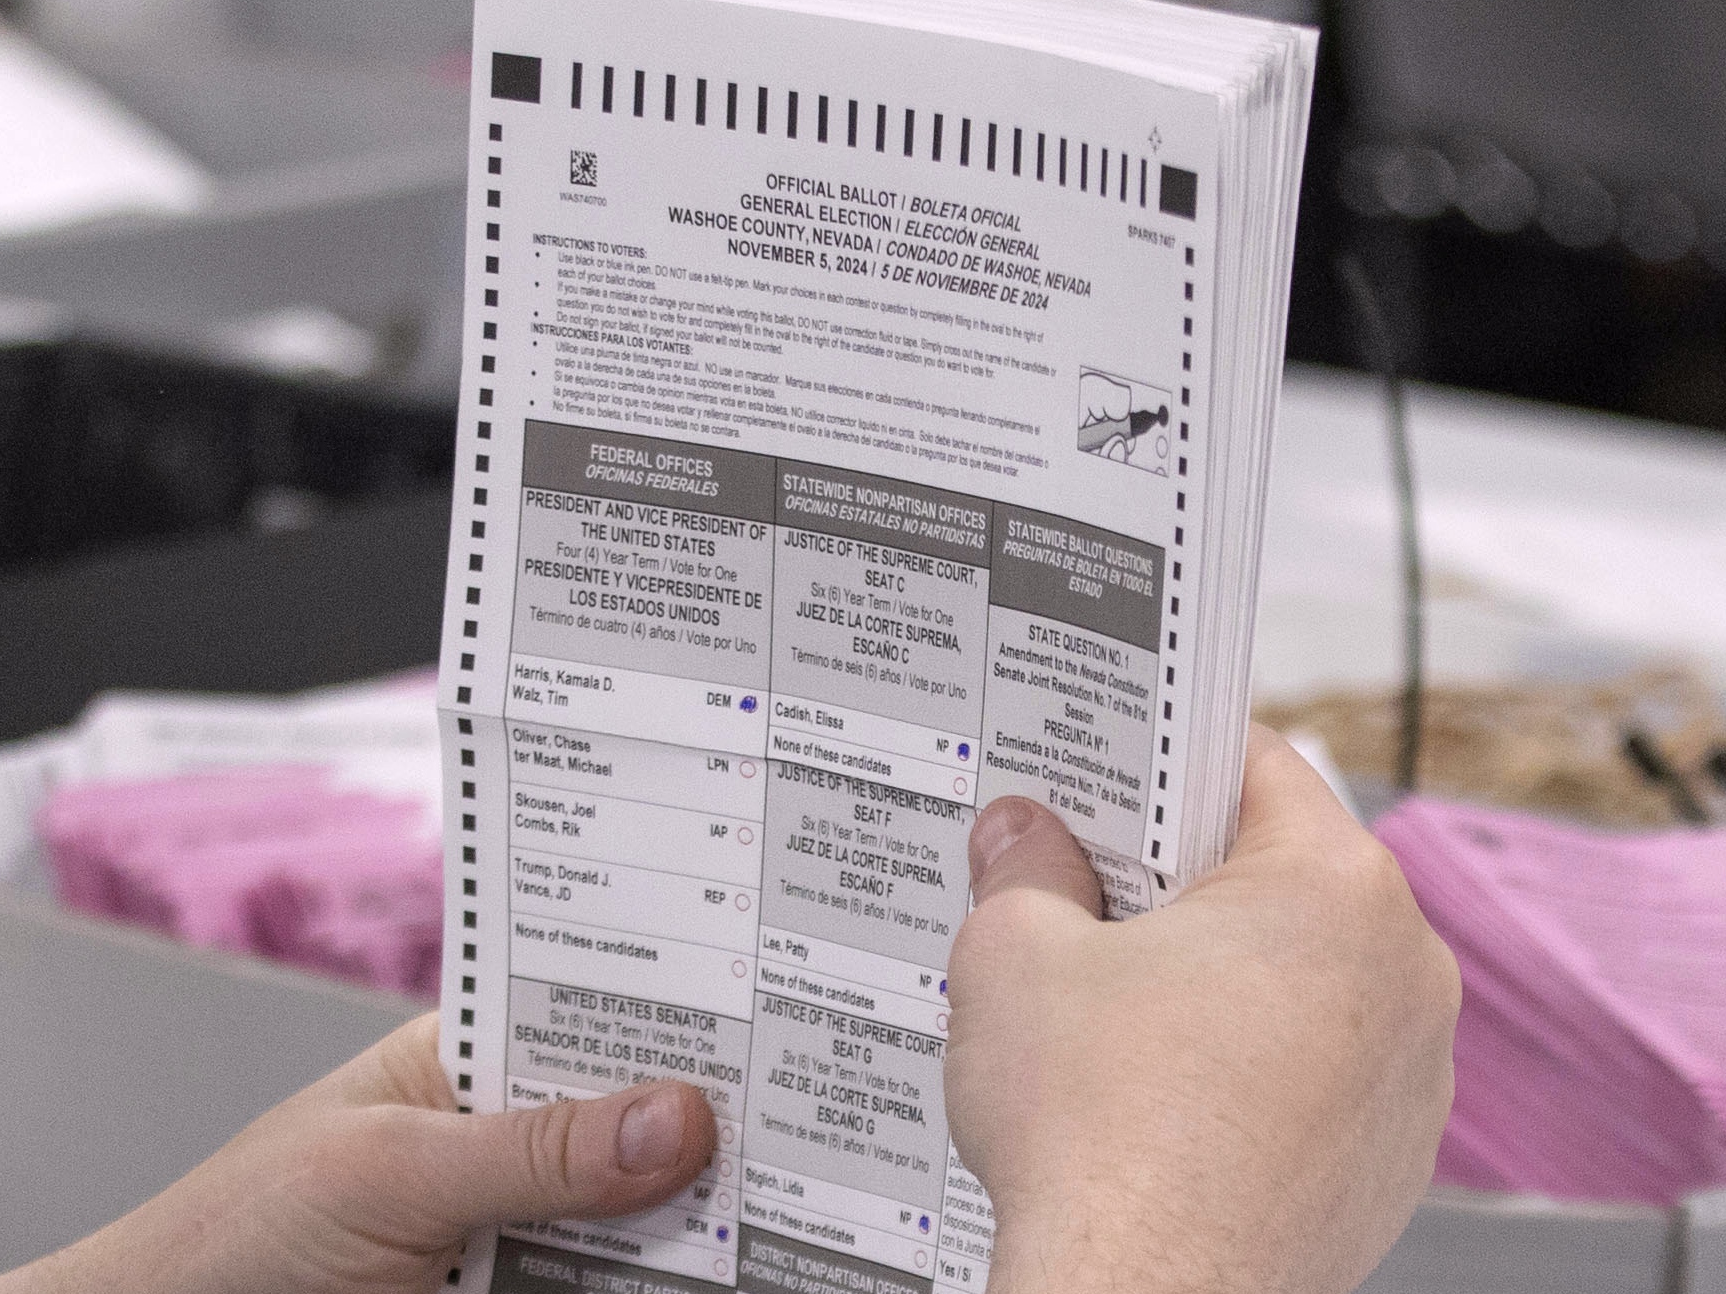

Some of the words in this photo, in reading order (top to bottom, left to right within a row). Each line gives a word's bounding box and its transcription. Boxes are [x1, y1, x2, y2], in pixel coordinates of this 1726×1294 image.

[765, 173, 837, 201] OFFICIAL
[839, 186, 897, 211] BALLOT
[908, 197, 968, 223] BOLETA
[969, 208, 1022, 232] OFICIAL
[740, 194, 816, 222] GENERAL
[818, 207, 892, 235] ELECTION
[903, 221, 977, 250] ELECCIÓN
[978, 234, 1041, 261] GENERAL
[532, 233, 595, 252] INSTRUCTIONS
[597, 242, 609, 254] TO
[610, 244, 648, 259] VOTERS:
[668, 206, 738, 234] WASHOE
[740, 219, 809, 250] COUNTY,
[811, 232, 873, 258] NEVADA
[884, 245, 957, 273] CONDADO
[959, 258, 979, 277] DE
[982, 262, 1042, 291] WASHOE,
[1043, 273, 1092, 297] NEVADA
[727, 239, 815, 269] NOVEMBER
[819, 254, 831, 276] 5,
[835, 257, 867, 279] 2024
[879, 265, 889, 282] 5
[891, 267, 912, 286] DE
[914, 271, 997, 301] NOVIEMBRE
[999, 286, 1018, 305] DE
[1020, 290, 1050, 311] 2024
[530, 322, 599, 342] INSTRUCCIONES
[600, 332, 624, 346] PARA
[626, 336, 644, 349] LOS
[645, 338, 694, 356] VOTANTES:
[590, 443, 651, 468] FEDERAL
[654, 453, 713, 477] OFFICES
[584, 464, 644, 487] OFICINAS
[644, 472, 720, 497] FEDERALES
[526, 490, 602, 516] PRESIDENT
[604, 502, 634, 521] AND
[637, 506, 668, 526] VICE
[671, 512, 746, 538] PRESIDENT
[748, 523, 767, 541] OF
[783, 473, 853, 503] STATEWIDE
[855, 488, 936, 520] NONPARTISAN
[937, 504, 987, 530] OFFICES
[784, 494, 837, 519] OFICINAS
[838, 504, 901, 532] ESTATALES
[901, 517, 918, 535] NO
[918, 521, 987, 549] PARTIDISTAS
[581, 521, 607, 541] THE
[610, 526, 660, 549] UNITED
[663, 533, 716, 557] STATES
[1008, 520, 1066, 552] STATEWIDE
[1068, 536, 1105, 562] BALLOT
[1104, 546, 1154, 575] QUESTIONS
[556, 541, 581, 559] Four
[583, 545, 599, 565] (4)
[603, 548, 628, 566] Year
[632, 553, 660, 571] Term
[669, 558, 694, 576] Vote
[696, 562, 711, 579] for
[713, 565, 738, 582] One
[784, 529, 834, 555] JUSTICE
[836, 540, 852, 559] OF
[856, 544, 878, 564] THE
[880, 549, 934, 576] SUPREME
[935, 560, 979, 588] COURT,
[524, 558, 609, 586] PRESIDENTE
[614, 572, 623, 588] Y
[626, 574, 740, 606] VICEPRESIDENTE
[743, 591, 763, 610] DE
[865, 569, 895, 590] SEAT
[896, 575, 906, 592] C
[569, 589, 597, 608] LOS
[599, 593, 665, 618] ESTADOS
[667, 603, 721, 626] UNIDOS
[796, 601, 826, 623] JUEZ
[828, 608, 844, 627] DE
[846, 612, 862, 631] LA
[864, 616, 903, 639] CORTE
[905, 624, 962, 655] SUPREMA,
[852, 636, 899, 661] ESCAÑO
[900, 646, 910, 664] C
[1028, 624, 1060, 649] STATE
[1062, 634, 1107, 662] QUESTION
[1107, 647, 1124, 668] NO.
[1124, 652, 1130, 669] 1
[515, 663, 552, 686] Harris,
[555, 669, 600, 690] Kamala
[602, 676, 616, 692] D.
[512, 685, 543, 706] Walz,
[547, 690, 569, 707] Tim
[706, 692, 732, 708] DEM
[775, 701, 813, 726] Cadish,
[814, 710, 844, 730] Elissa
[512, 728, 550, 749] Oliver,
[553, 734, 592, 753] Chase
[936, 737, 950, 753] NP
[513, 749, 529, 765] ter
[532, 752, 564, 772] Maat,
[566, 757, 613, 777] Michael
[707, 757, 730, 773] LPN
[515, 792, 568, 816] Skousen,
[571, 801, 597, 818] Joel
[515, 813, 558, 836] Combs,
[560, 820, 581, 837] Rik
[709, 823, 728, 839] IAP
[515, 857, 555, 880] Trump,
[557, 864, 599, 885] Donald
[601, 871, 612, 887] J.
[515, 878, 553, 901] Vance,
[556, 885, 572, 901] JD
[704, 888, 726, 905] REP
[515, 922, 545, 941] None
[547, 929, 559, 944] of
[561, 930, 593, 949] these
[595, 939, 659, 961] candidates
[763, 934, 783, 955] Lee,
[784, 939, 810, 962] Patty
[919, 973, 932, 988] NP
[549, 986, 597, 1010] UNITED
[600, 995, 652, 1021] STATES
[655, 1006, 717, 1033] SENATOR
[745, 1166, 781, 1194] Stiglich,
[782, 1176, 805, 1197] Lidia
[899, 1210, 912, 1225] NP
[520, 1257, 577, 1284] FEDERAL
[750, 1240, 796, 1269] DISTRICT
[796, 1254, 874, 1293] NONPARTISAN
